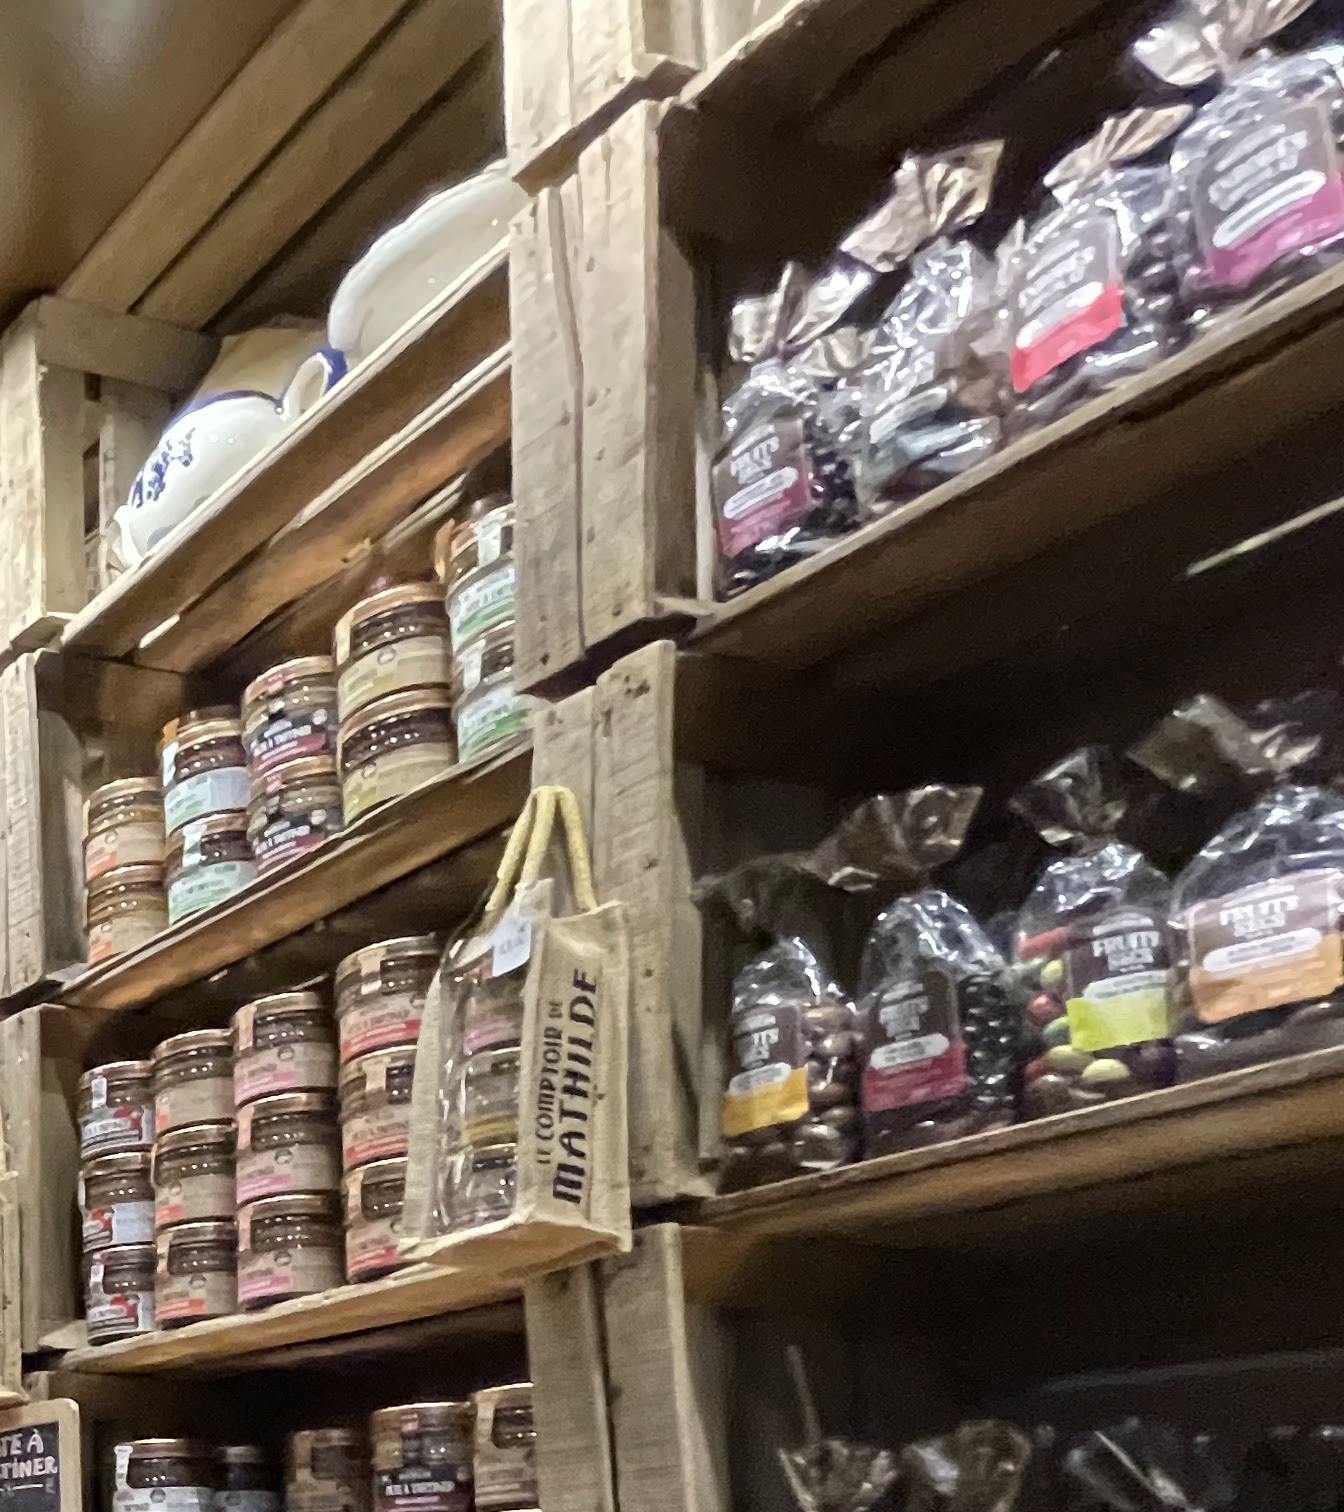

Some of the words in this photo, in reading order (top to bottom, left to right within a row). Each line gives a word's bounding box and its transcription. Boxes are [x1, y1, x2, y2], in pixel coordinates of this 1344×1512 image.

[535, 1026, 563, 1140] COMPTOIR
[552, 969, 597, 1204] MATHILDE
[27, 1428, 44, 1454] À
